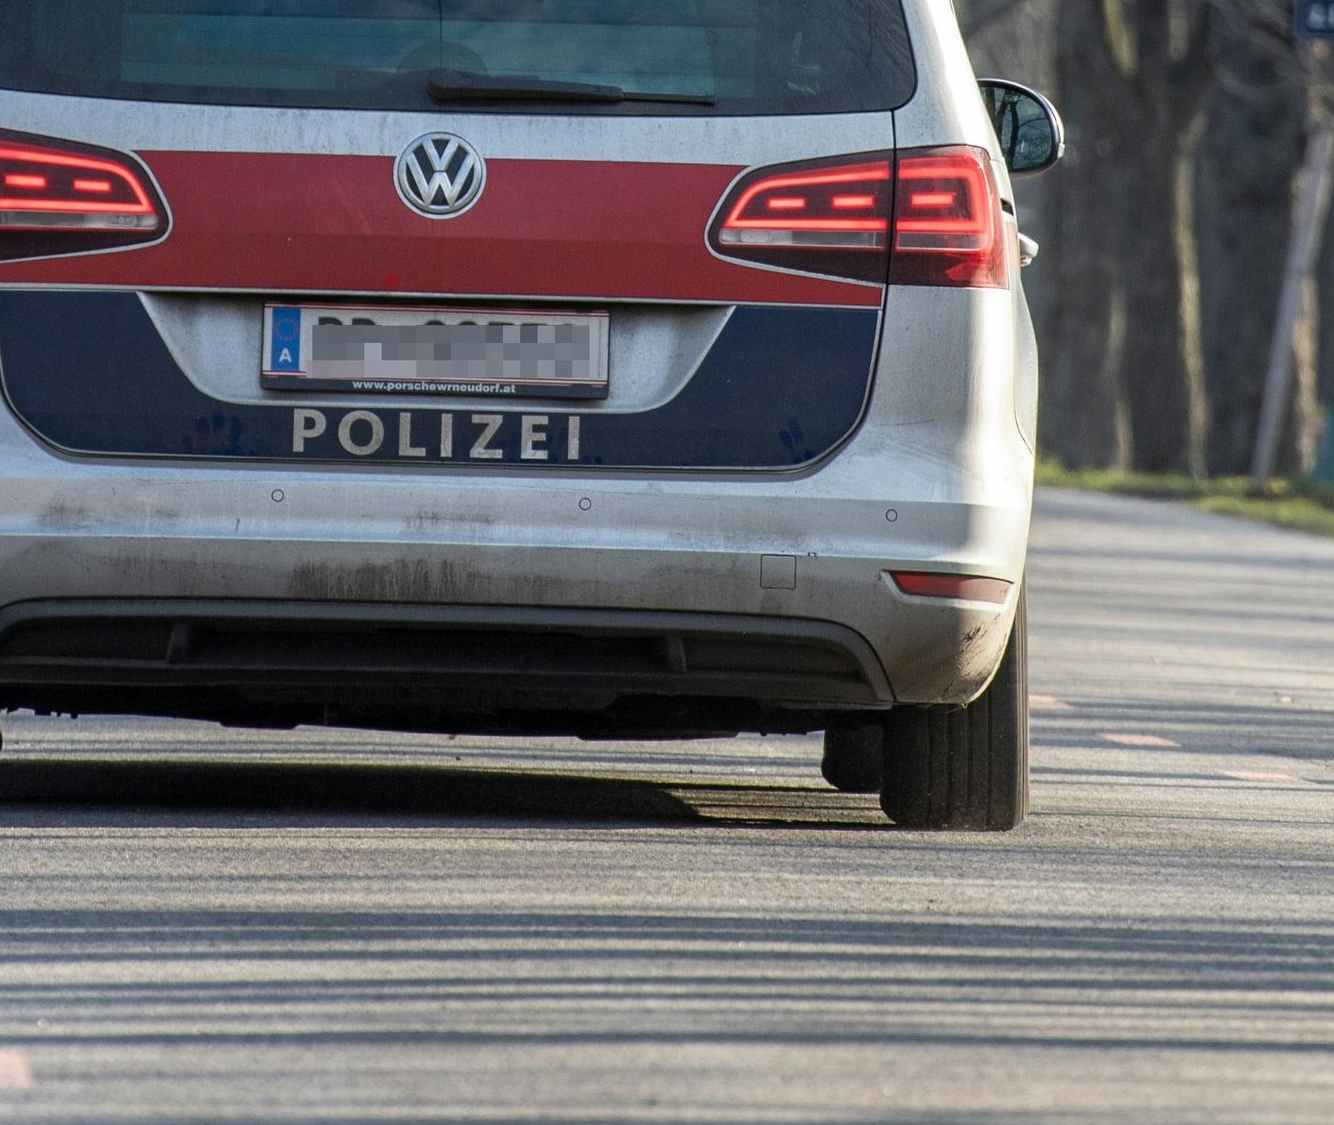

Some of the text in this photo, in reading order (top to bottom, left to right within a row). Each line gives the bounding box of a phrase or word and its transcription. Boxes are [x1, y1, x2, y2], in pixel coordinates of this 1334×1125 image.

[399, 133, 481, 213] VW
[278, 347, 292, 363] A
[352, 380, 516, 394] www.porschewrneudorf.at
[292, 408, 580, 460] POLIZEI
